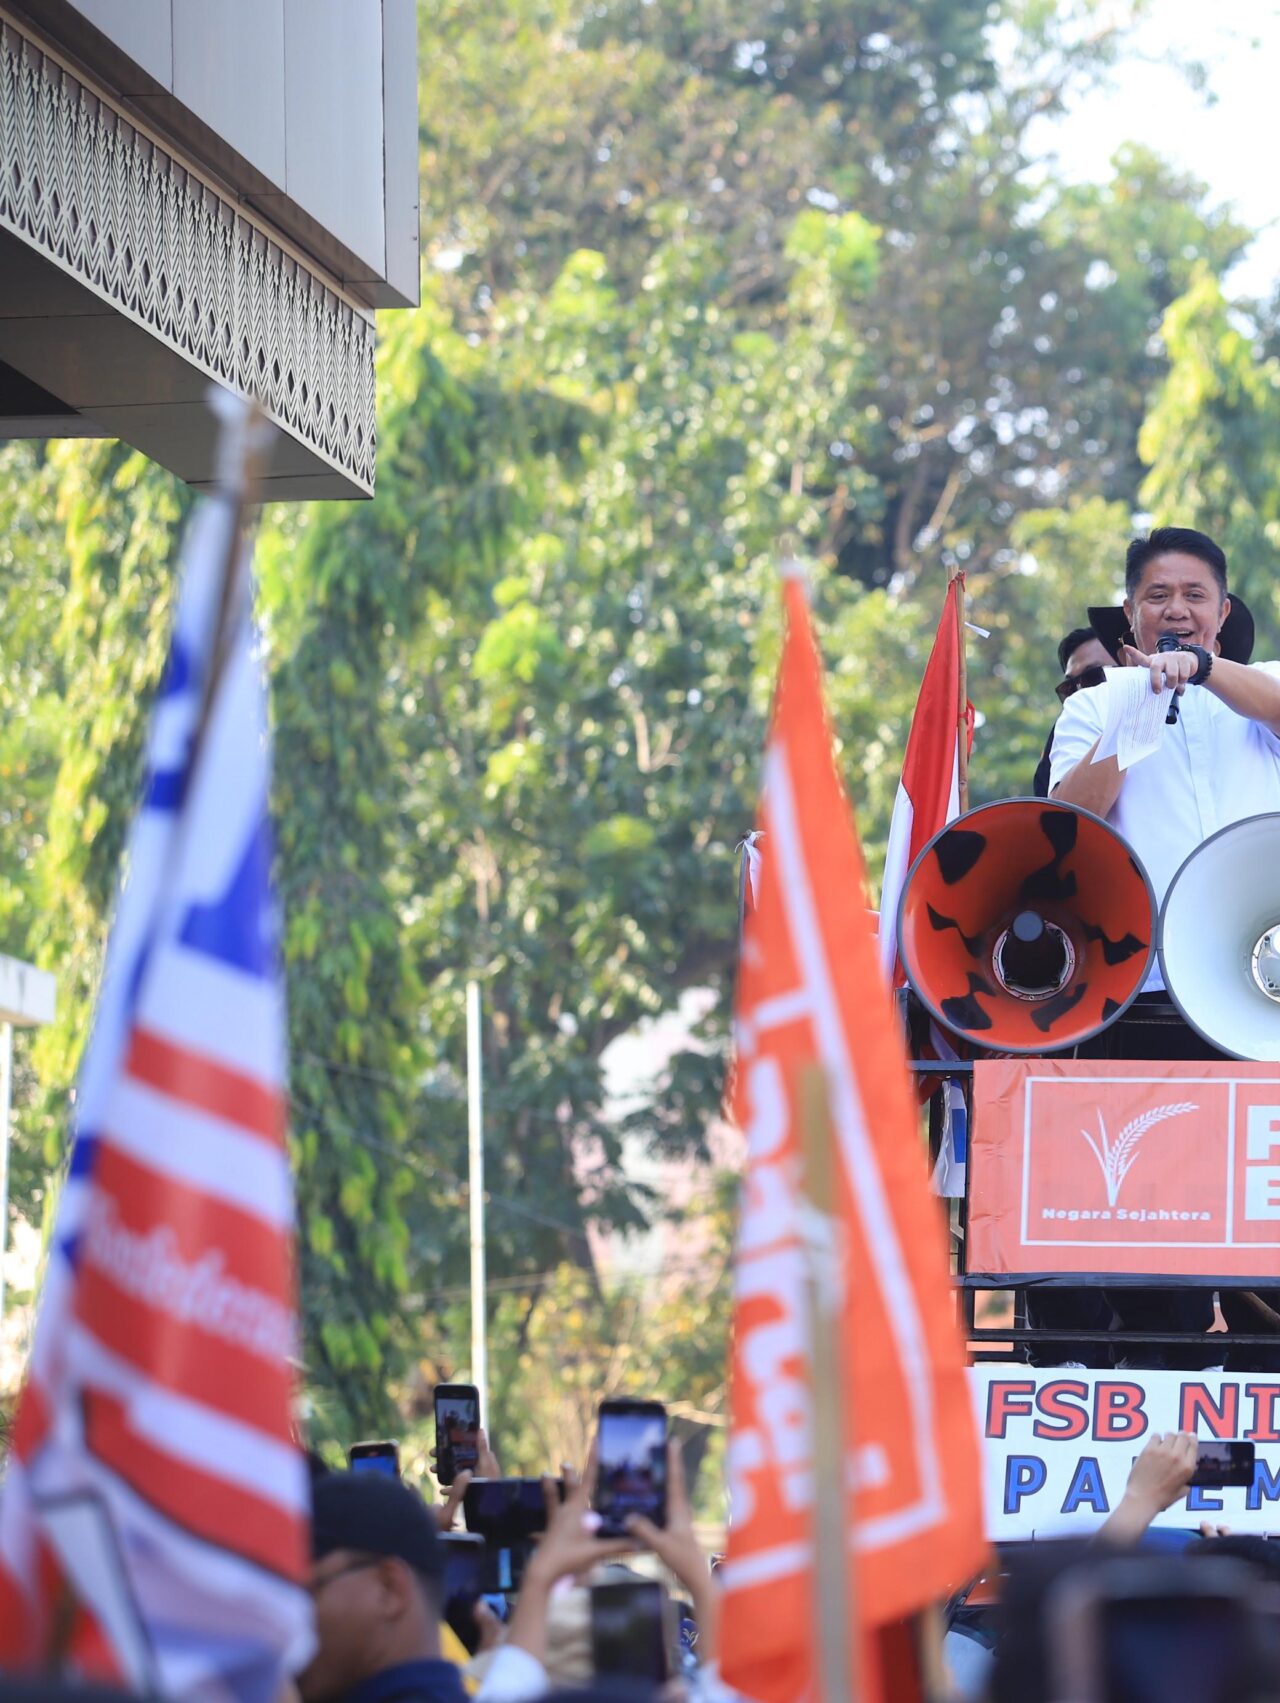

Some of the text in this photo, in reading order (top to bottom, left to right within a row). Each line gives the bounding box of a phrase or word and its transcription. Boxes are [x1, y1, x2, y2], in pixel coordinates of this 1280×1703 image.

[1042, 1208, 1212, 1222] Negara Sejahtera
[984, 1380, 1148, 1441] FSB
